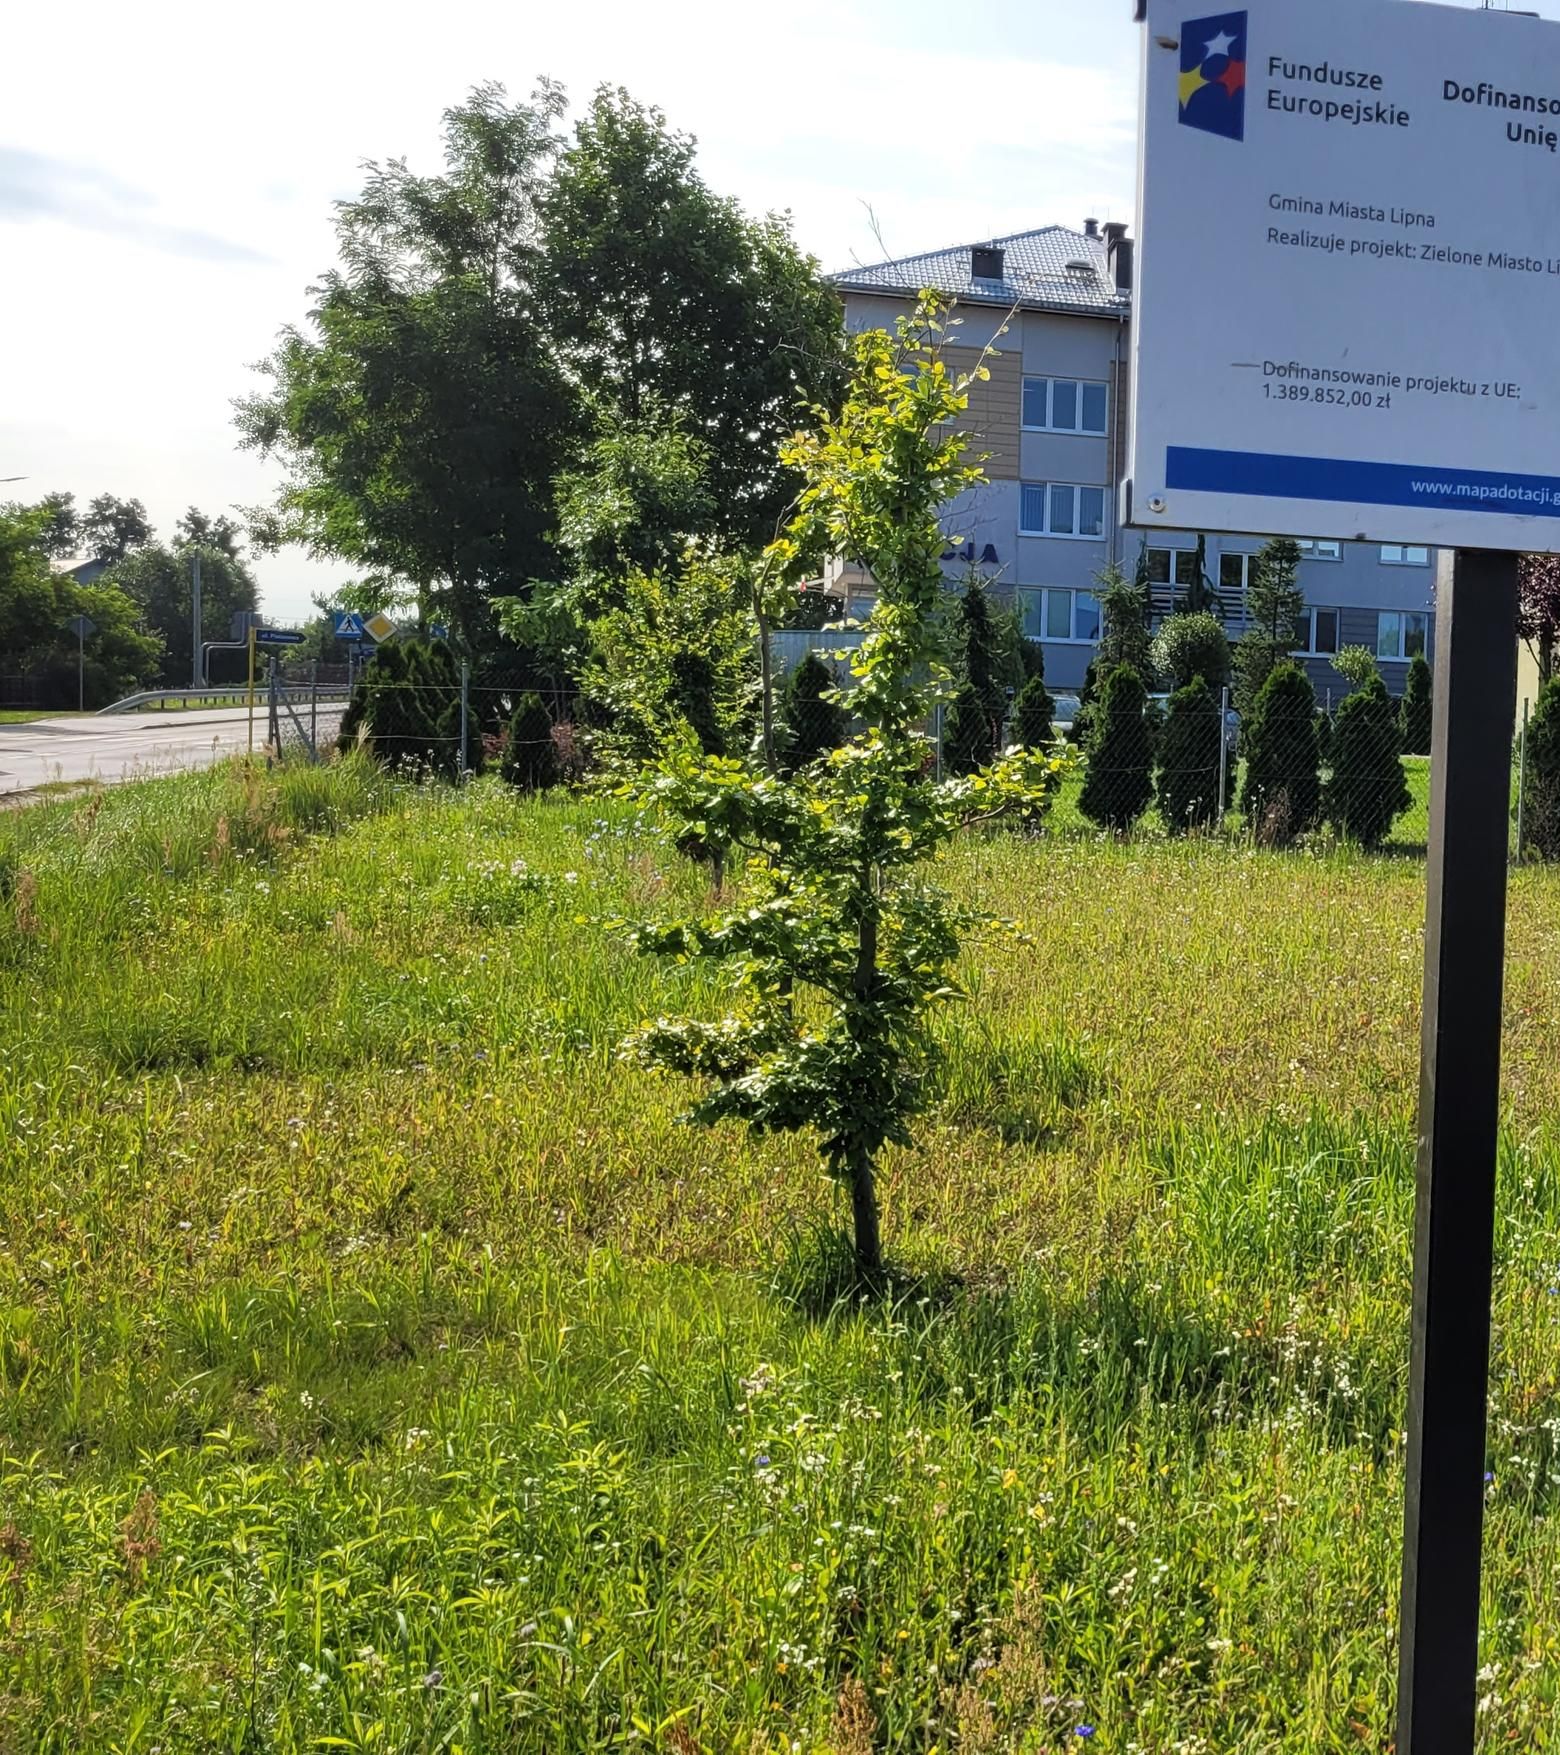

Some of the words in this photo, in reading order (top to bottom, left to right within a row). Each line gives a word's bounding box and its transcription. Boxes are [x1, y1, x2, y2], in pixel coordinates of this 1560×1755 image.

[1269, 56, 1383, 91] Fundusze
[1268, 89, 1409, 127] Europejskie
[1507, 122, 1557, 152] Unię
[1269, 194, 1323, 215] Gmina
[1329, 201, 1384, 221] Miasta
[1391, 208, 1434, 228] Lipna
[1267, 227, 1345, 253] Realizuje
[1351, 240, 1416, 259] projekt:
[1420, 245, 1482, 266] Zielone
[1488, 253, 1542, 272] Miasto
[1264, 361, 1400, 387] Dofinansowanie
[1406, 376, 1476, 395] projektu
[1481, 384, 1489, 395] z
[1263, 383, 1371, 407] 1.389.852,00
[1376, 392, 1391, 408] zł
